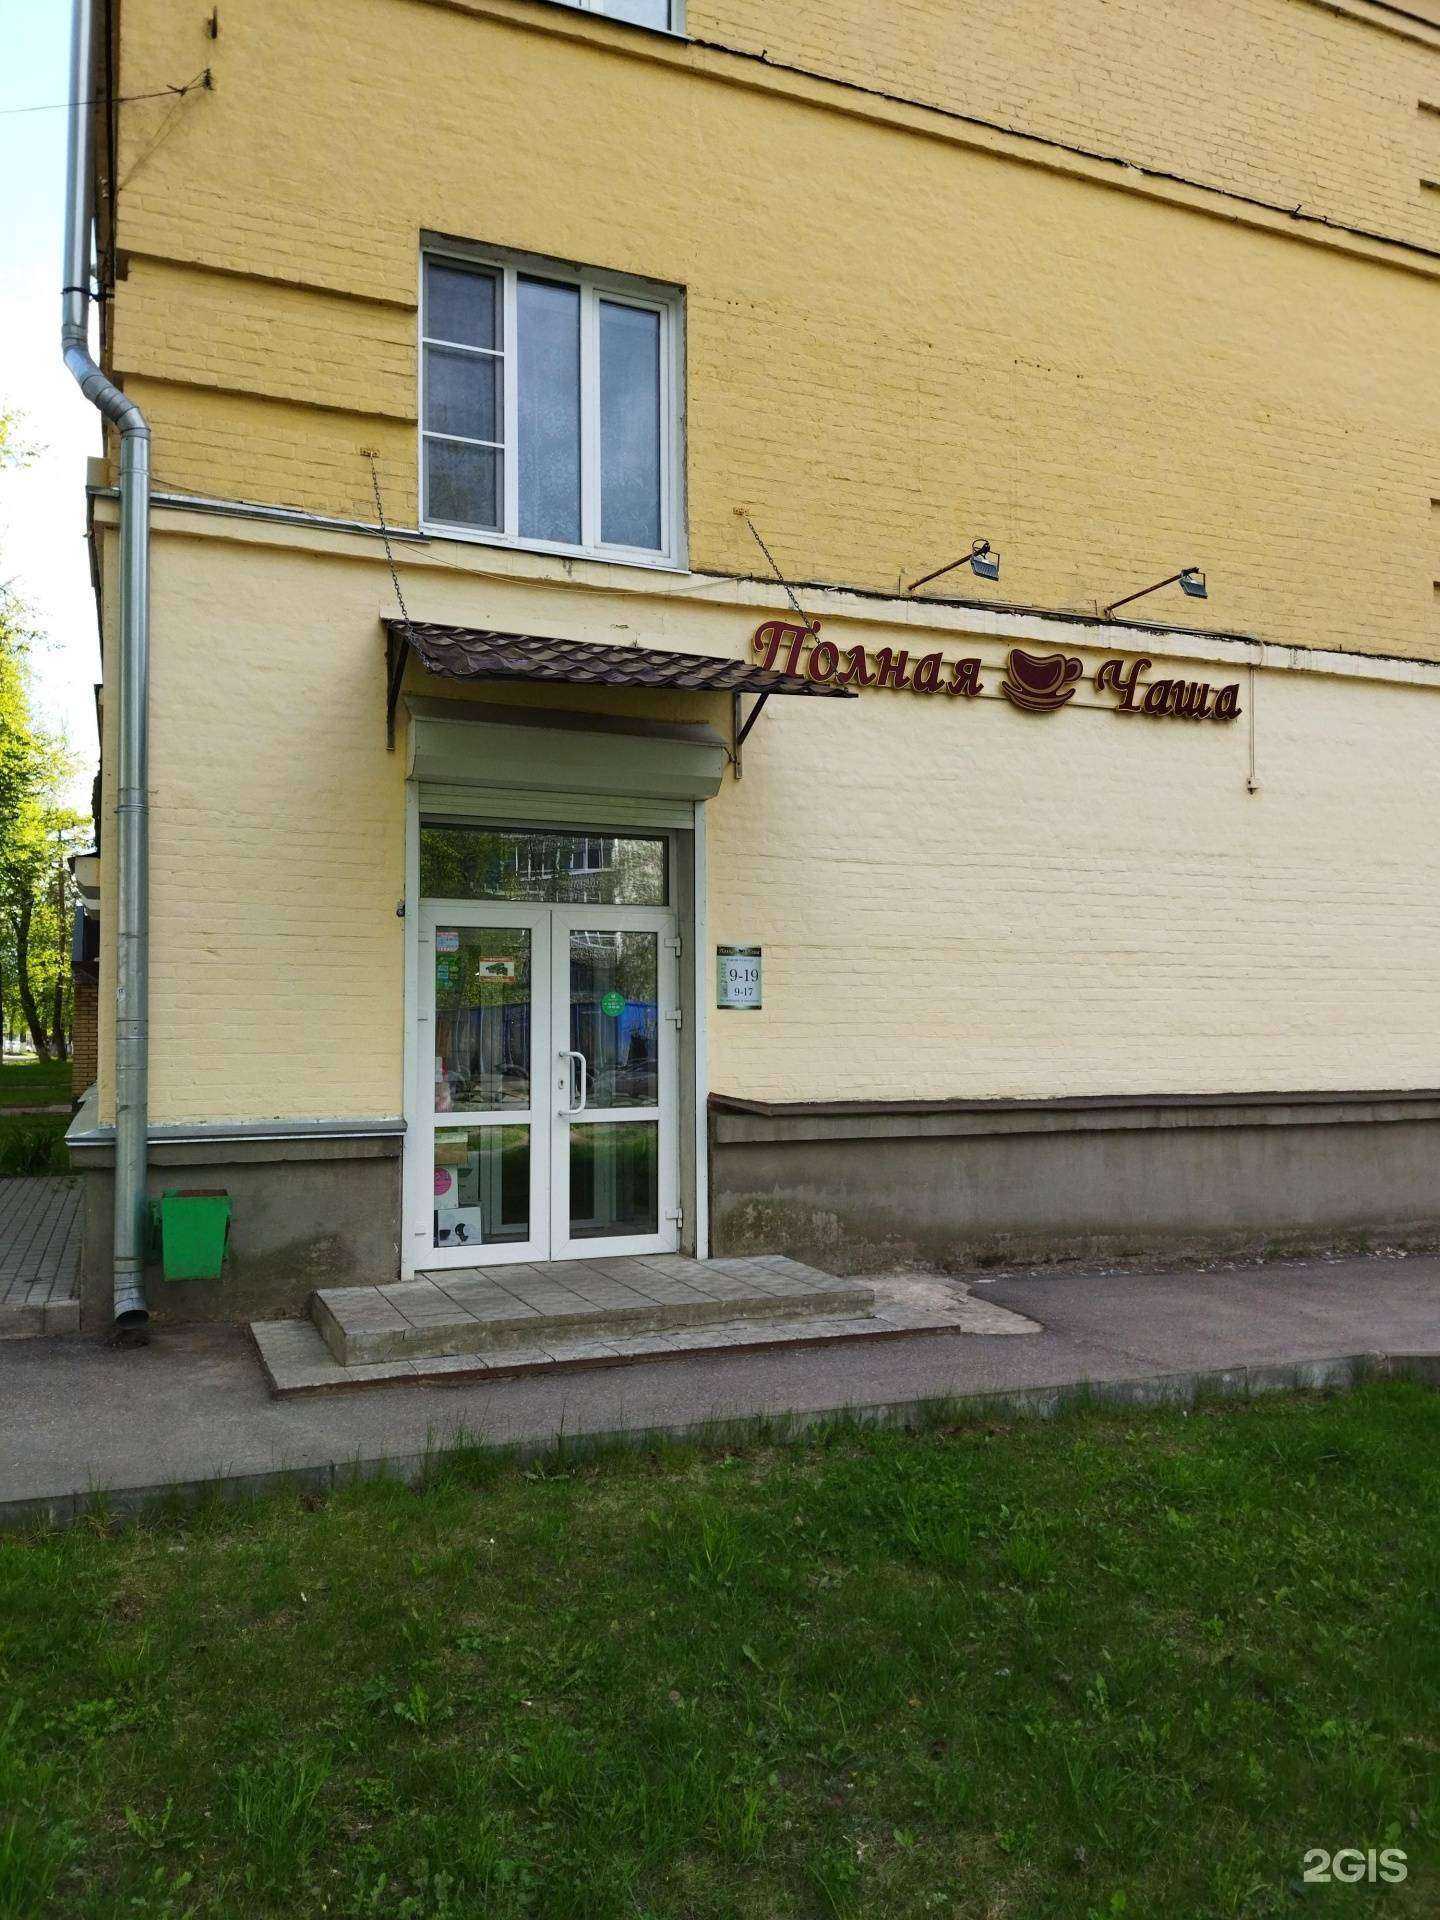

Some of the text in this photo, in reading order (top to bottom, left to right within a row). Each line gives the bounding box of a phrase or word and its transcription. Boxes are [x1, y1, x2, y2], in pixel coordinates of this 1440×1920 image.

[752, 619, 1243, 722] Полная Чаша
[729, 968, 759, 982] 9-19
[734, 987, 754, 997] 9-17
